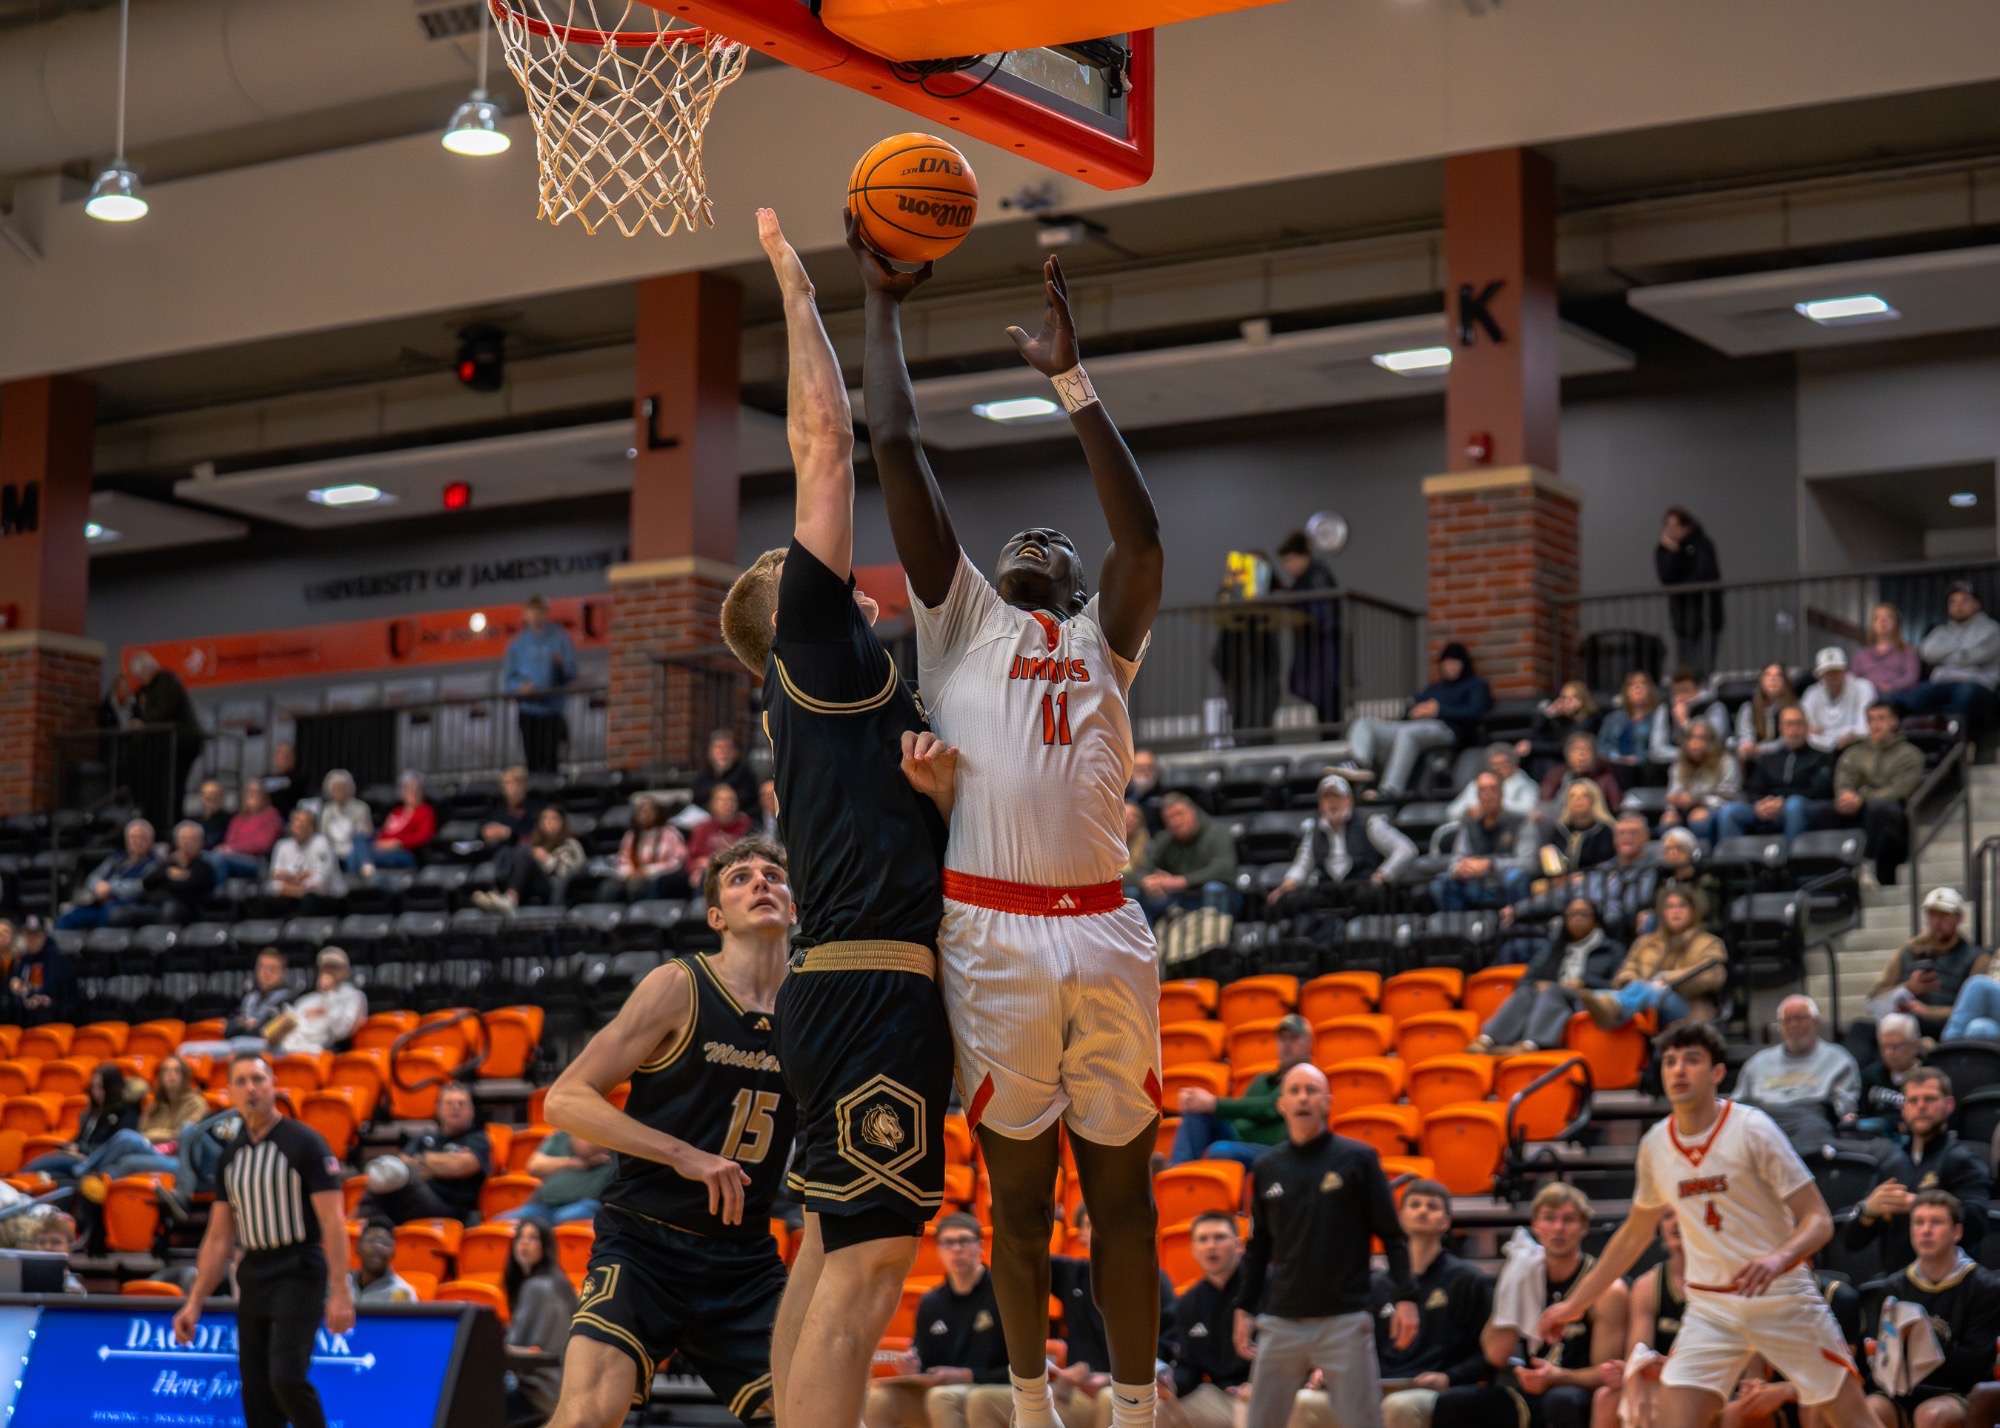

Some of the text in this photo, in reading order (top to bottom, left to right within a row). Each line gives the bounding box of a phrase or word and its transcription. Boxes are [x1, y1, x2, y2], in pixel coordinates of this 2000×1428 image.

[900, 157, 964, 177] EVO NXT
[897, 194, 973, 228] Wilson
[1459, 281, 1506, 346] K
[644, 395, 681, 450] L
[1, 482, 40, 535] M
[1041, 691, 1072, 745] 11
[703, 1041, 781, 1073] Musta
[720, 1087, 781, 1164] 15
[1704, 1200, 1723, 1232] 4
